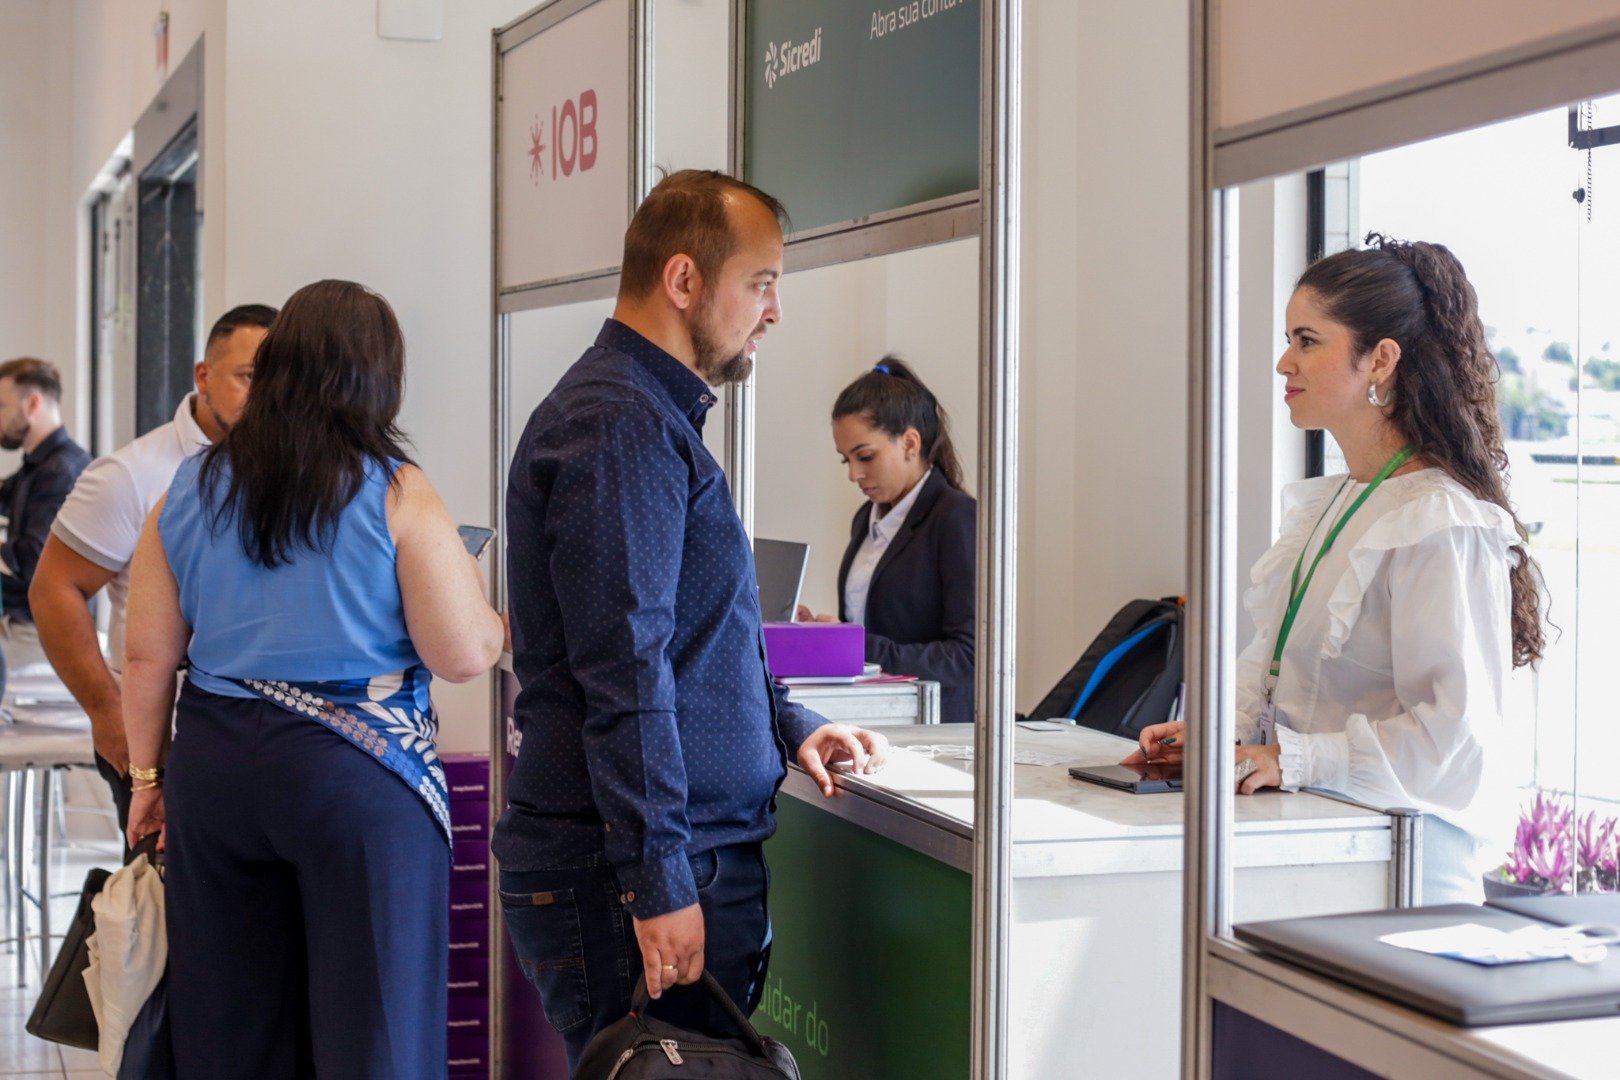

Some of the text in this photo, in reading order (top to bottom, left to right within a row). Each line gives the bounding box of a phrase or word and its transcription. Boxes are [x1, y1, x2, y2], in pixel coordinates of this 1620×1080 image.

[870, 9, 897, 40] Abra
[898, 1, 919, 29] sua
[780, 27, 822, 77] Sicredi
[552, 88, 598, 181] IOB
[506, 716, 523, 758] Re
[805, 1000, 829, 1056] do
